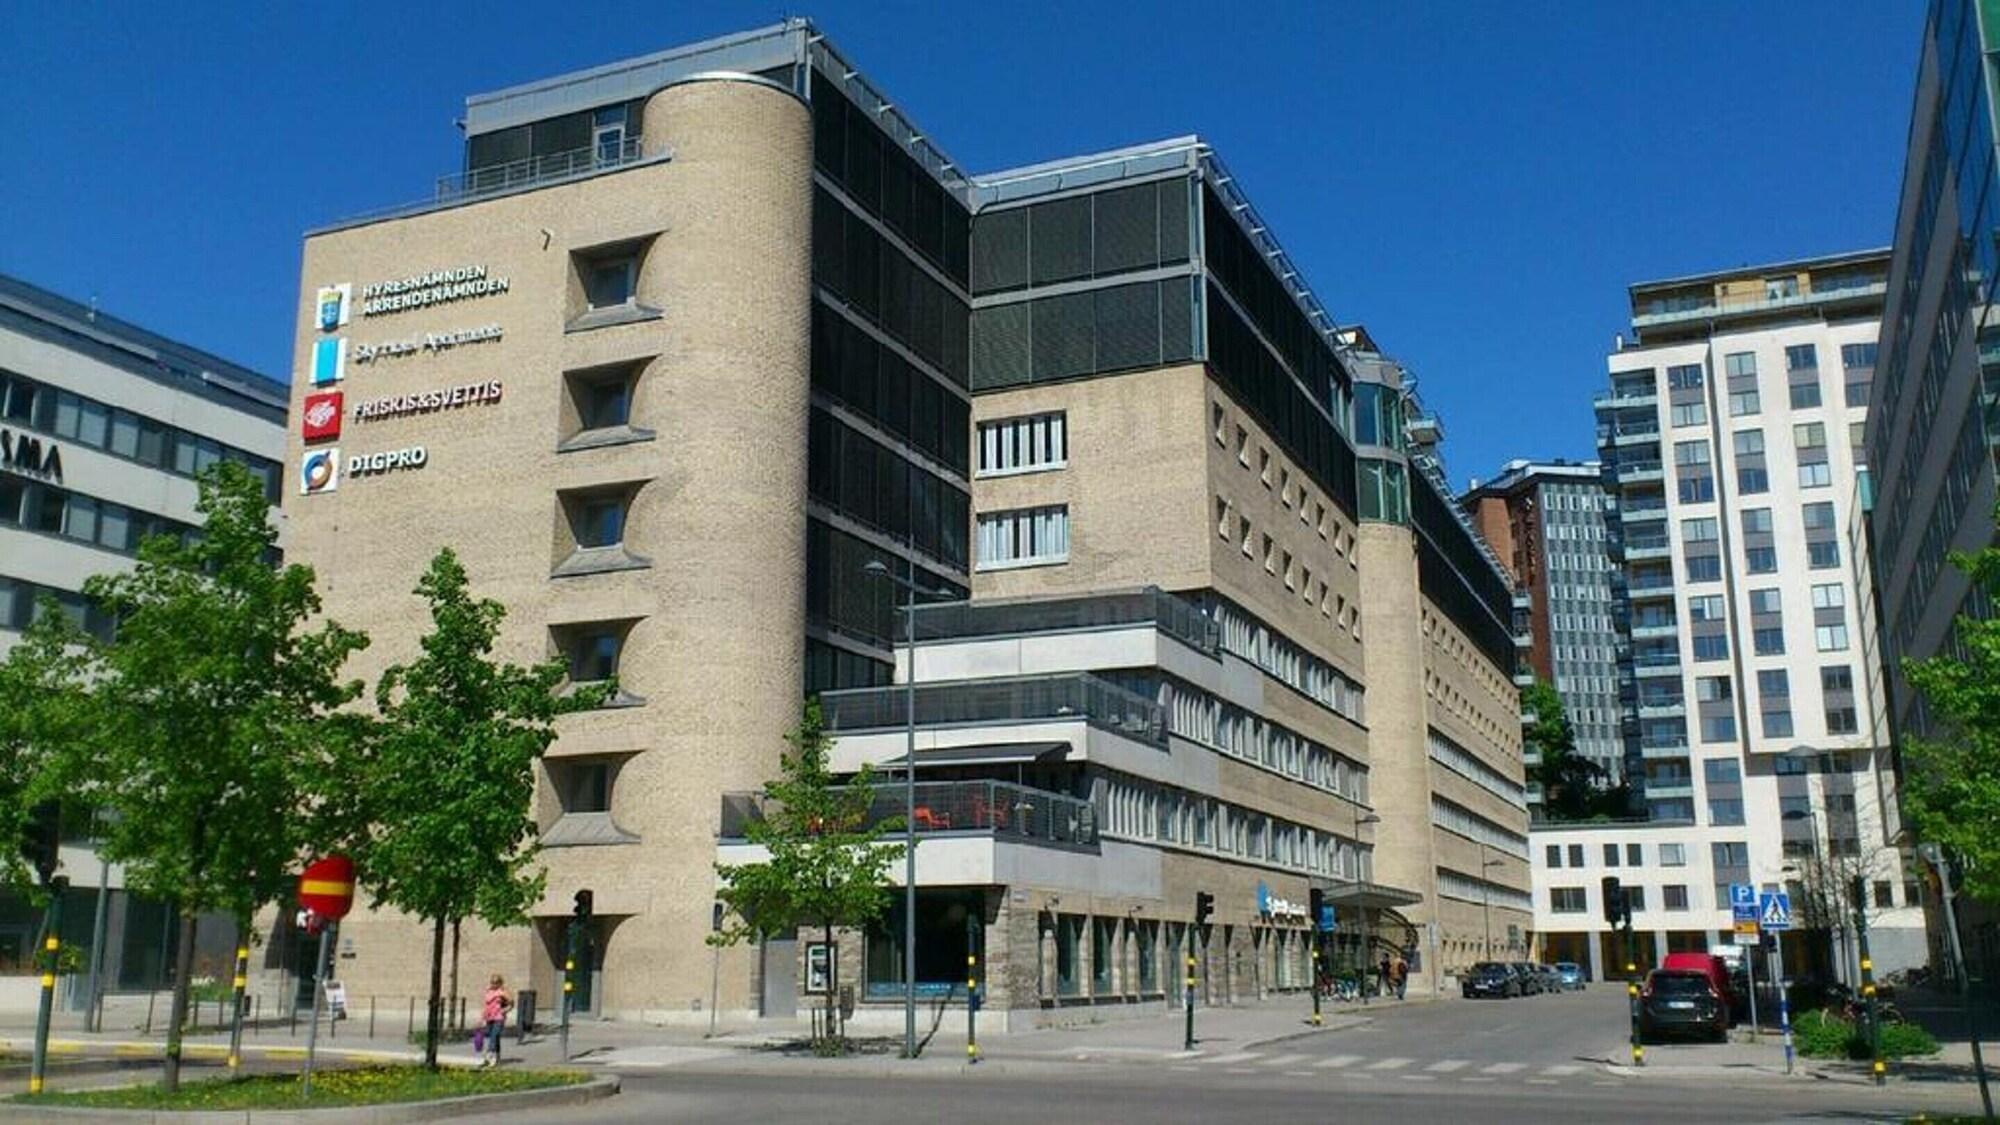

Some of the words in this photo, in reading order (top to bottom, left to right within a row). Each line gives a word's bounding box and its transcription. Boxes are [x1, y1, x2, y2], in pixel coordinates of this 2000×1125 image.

[363, 264, 487, 298] HYRESNÄMNDEN
[363, 277, 508, 314] ARRENDENÄMNDEN
[353, 380, 501, 417] FRISKIS&SVETTIS
[1, 429, 63, 481] SMA
[349, 446, 425, 472] DIGPRO
